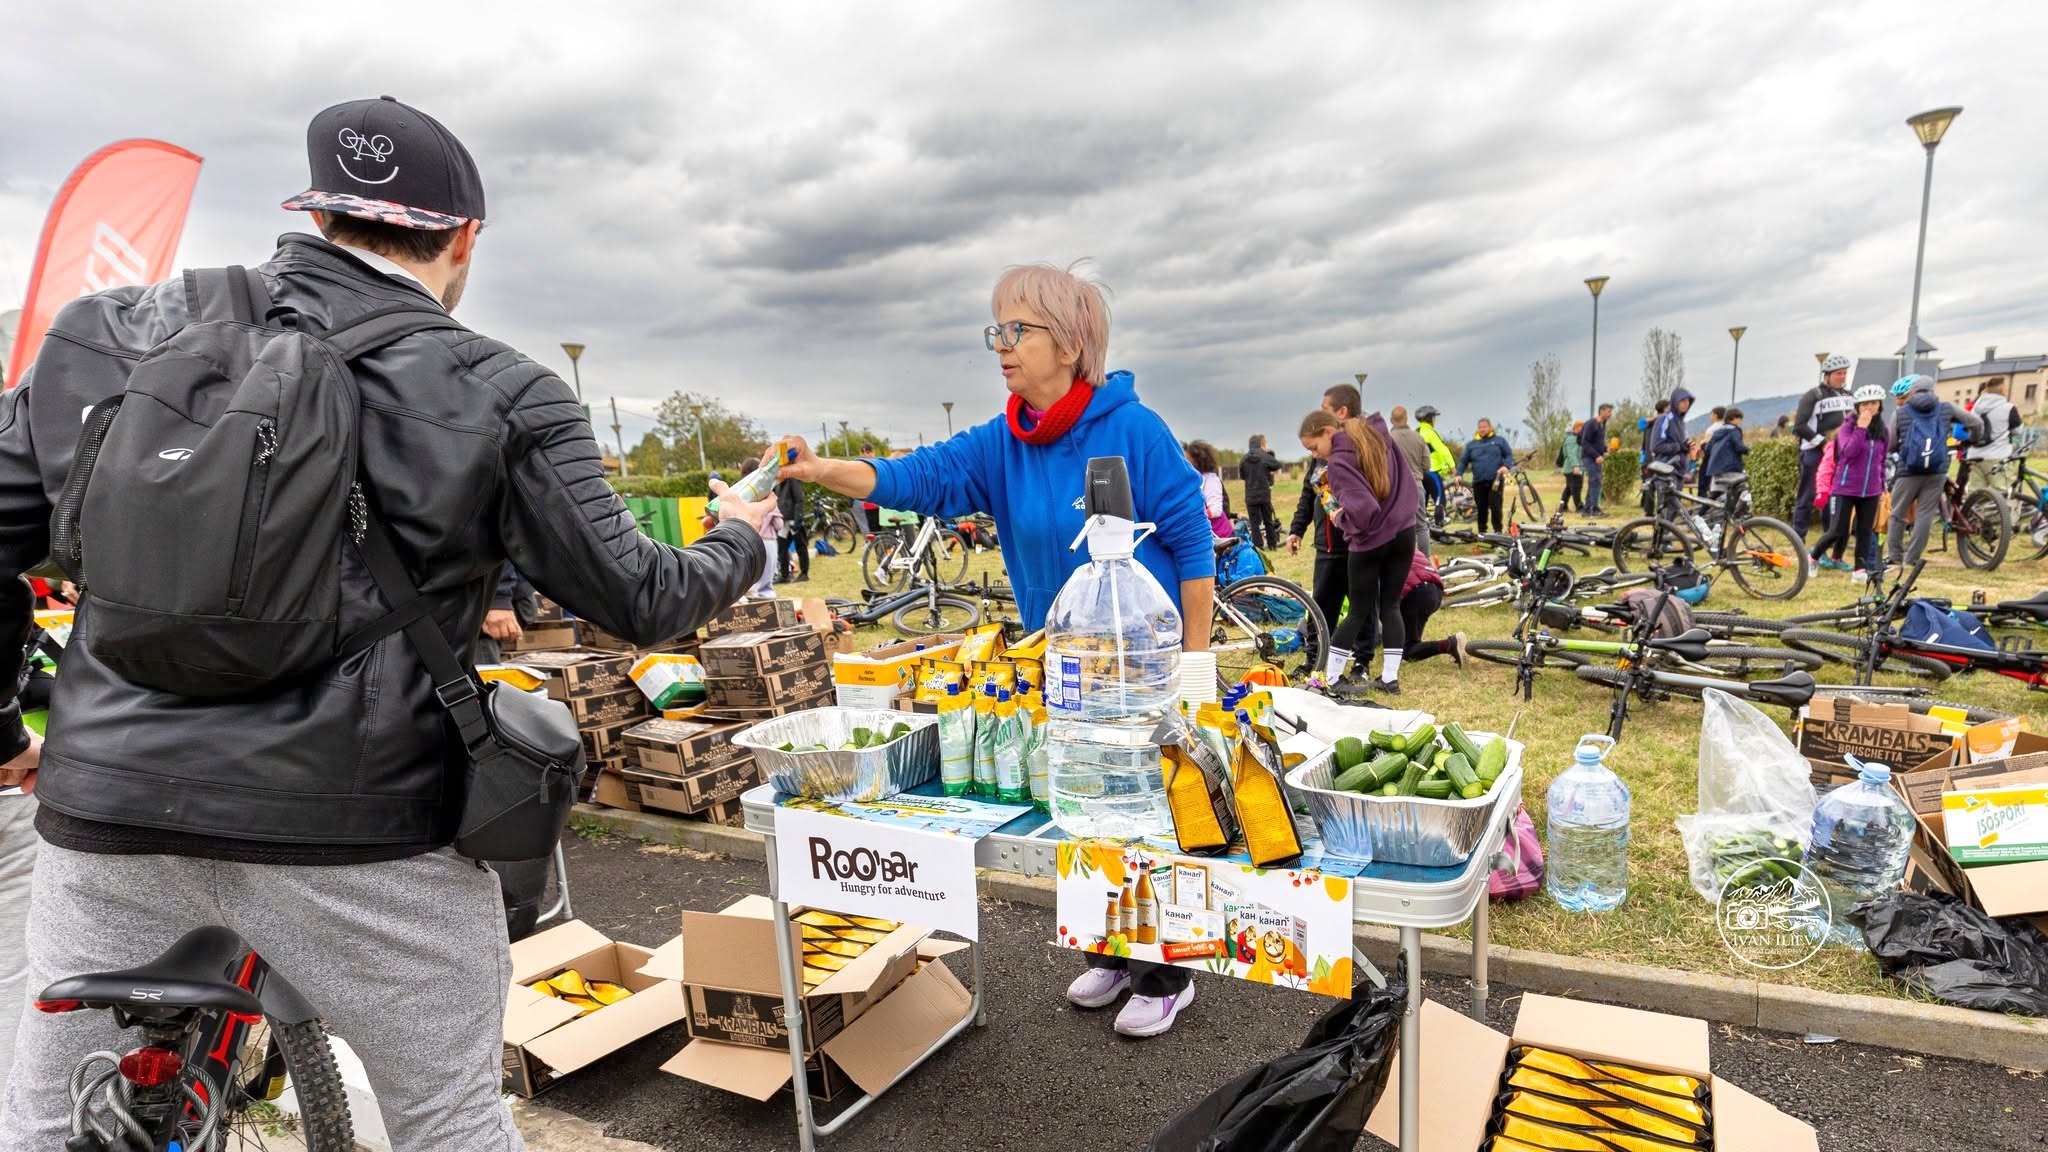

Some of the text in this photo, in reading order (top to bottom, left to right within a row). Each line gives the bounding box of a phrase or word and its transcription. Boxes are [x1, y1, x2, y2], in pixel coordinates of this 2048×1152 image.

[1824, 720, 1929, 752] KRAMBALS
[1838, 743, 1903, 762] BRUSCHETTA
[1976, 799, 2027, 837] ISOSPORT
[840, 881, 947, 901] Hungry for adventure
[718, 1015, 778, 1037] KRAMBALS
